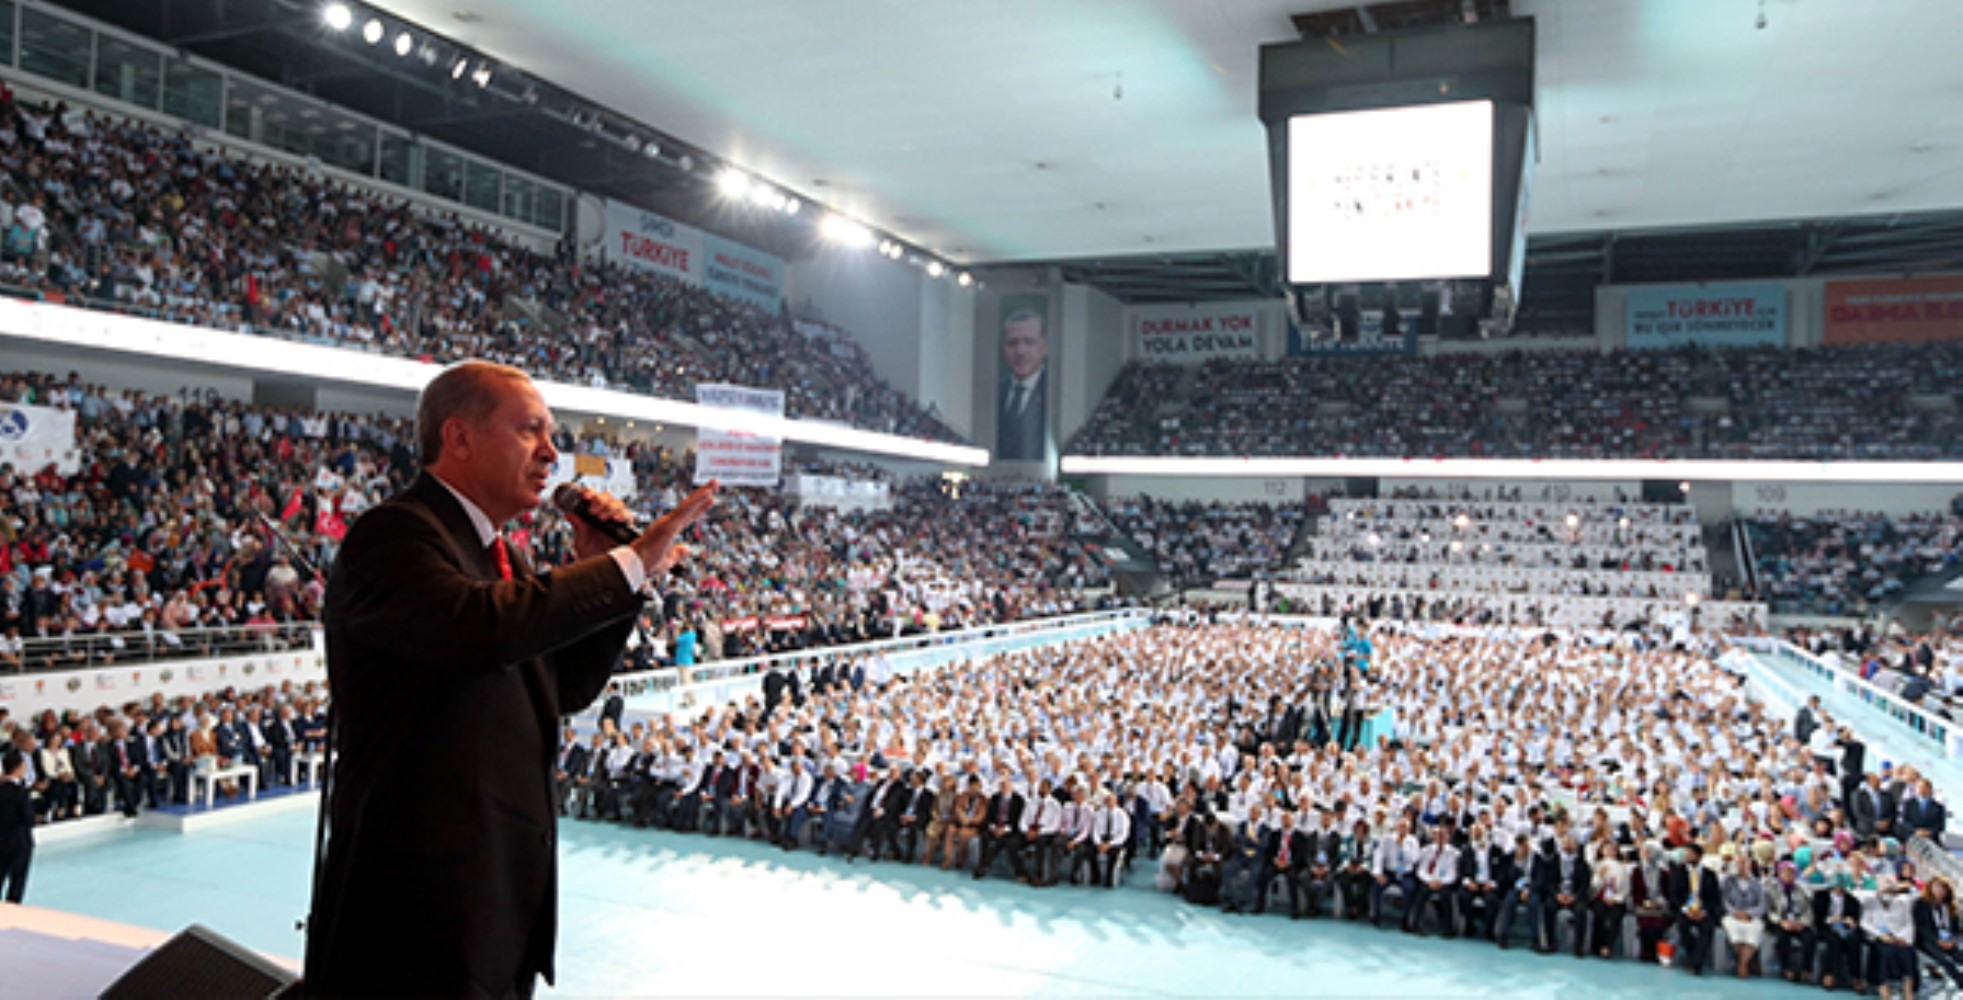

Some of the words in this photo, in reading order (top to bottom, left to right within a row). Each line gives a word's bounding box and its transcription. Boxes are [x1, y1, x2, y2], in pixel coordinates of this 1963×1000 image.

[1142, 317, 1213, 335] DURMAK
[1218, 314, 1253, 331] YOK
[1143, 336, 1188, 353] YOLA
[1192, 333, 1253, 351] DEVAM
